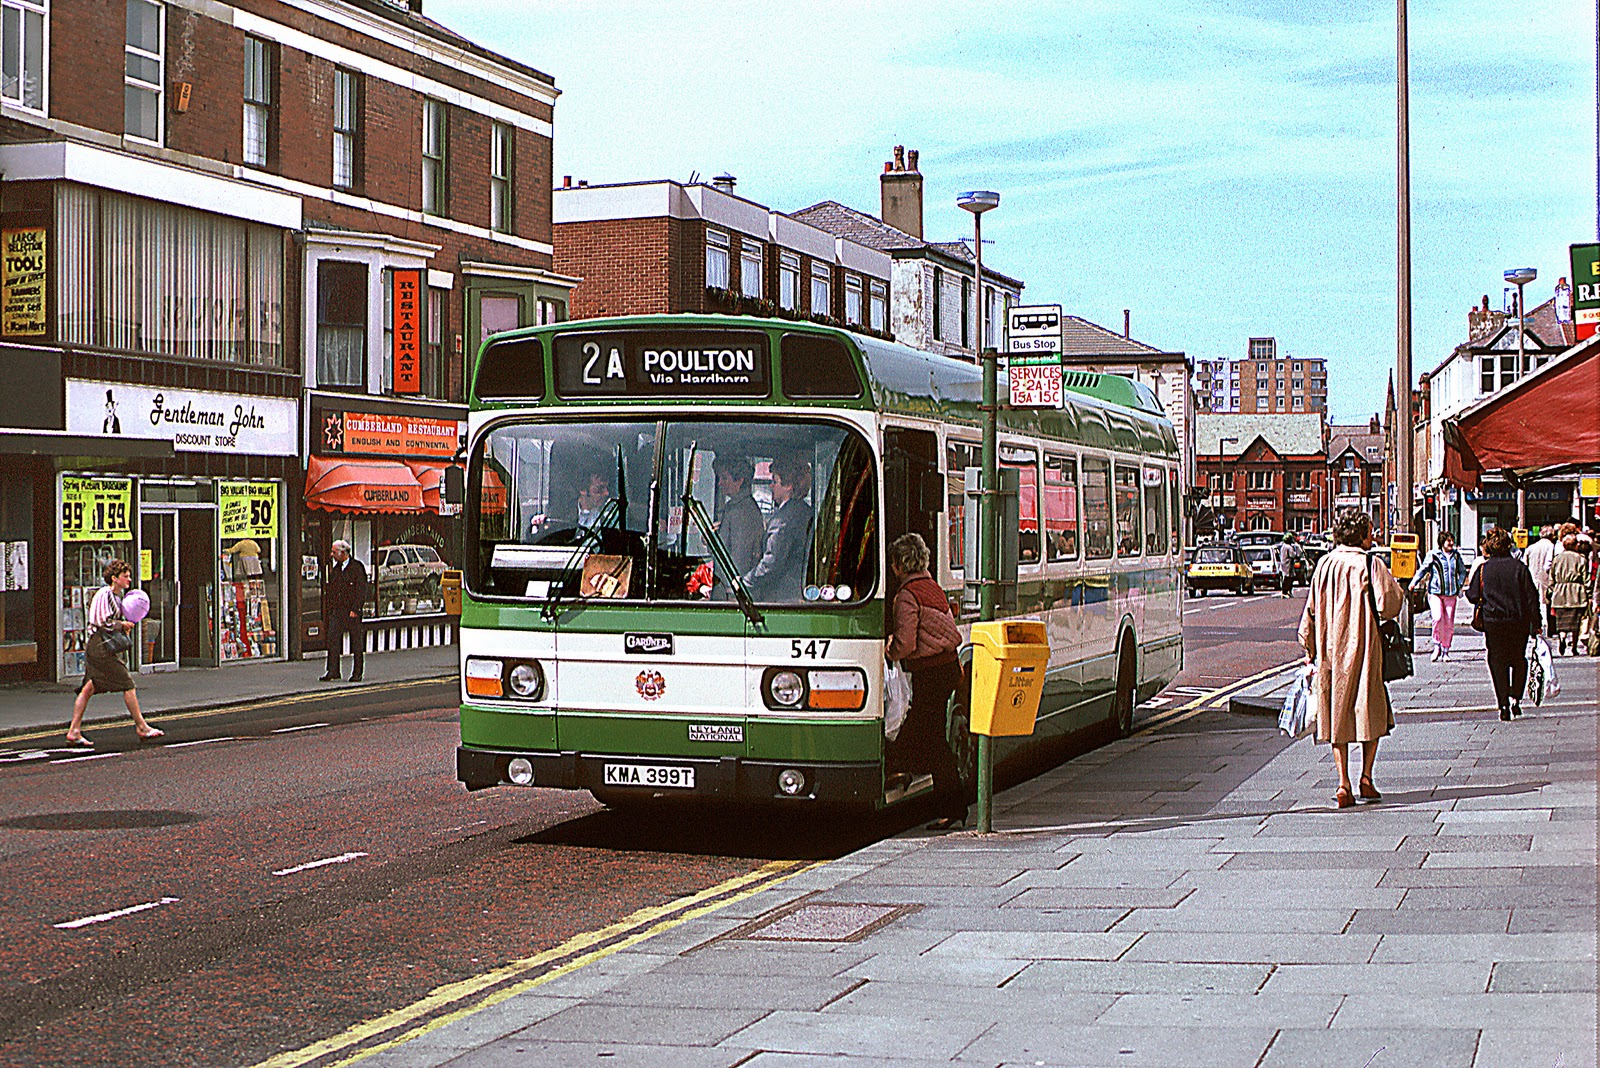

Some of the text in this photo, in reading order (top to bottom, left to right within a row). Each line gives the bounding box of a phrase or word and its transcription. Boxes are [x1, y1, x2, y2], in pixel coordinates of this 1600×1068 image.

[6, 256, 43, 272] TOOLS
[400, 281, 415, 382] RESTAURANT
[1013, 340, 1056, 350] Bus Stop
[583, 341, 754, 384] 2A POULTON
[680, 373, 750, 384] Hardhorn
[1010, 367, 1063, 380] SERVICES
[150, 393, 265, 436] Gentleman John
[346, 419, 456, 436] CUMBERLAND RESTAURANT
[175, 433, 236, 448] DISCOUNT STORE
[351, 437, 450, 450] ENGLISH AND CONTINENTAL
[364, 489, 410, 502] CUMBERLAND
[626, 635, 671, 651] GARDNER
[791, 639, 832, 659] 547
[690, 726, 742, 734] LEYLAND
[606, 766, 692, 785] KMA 399T
